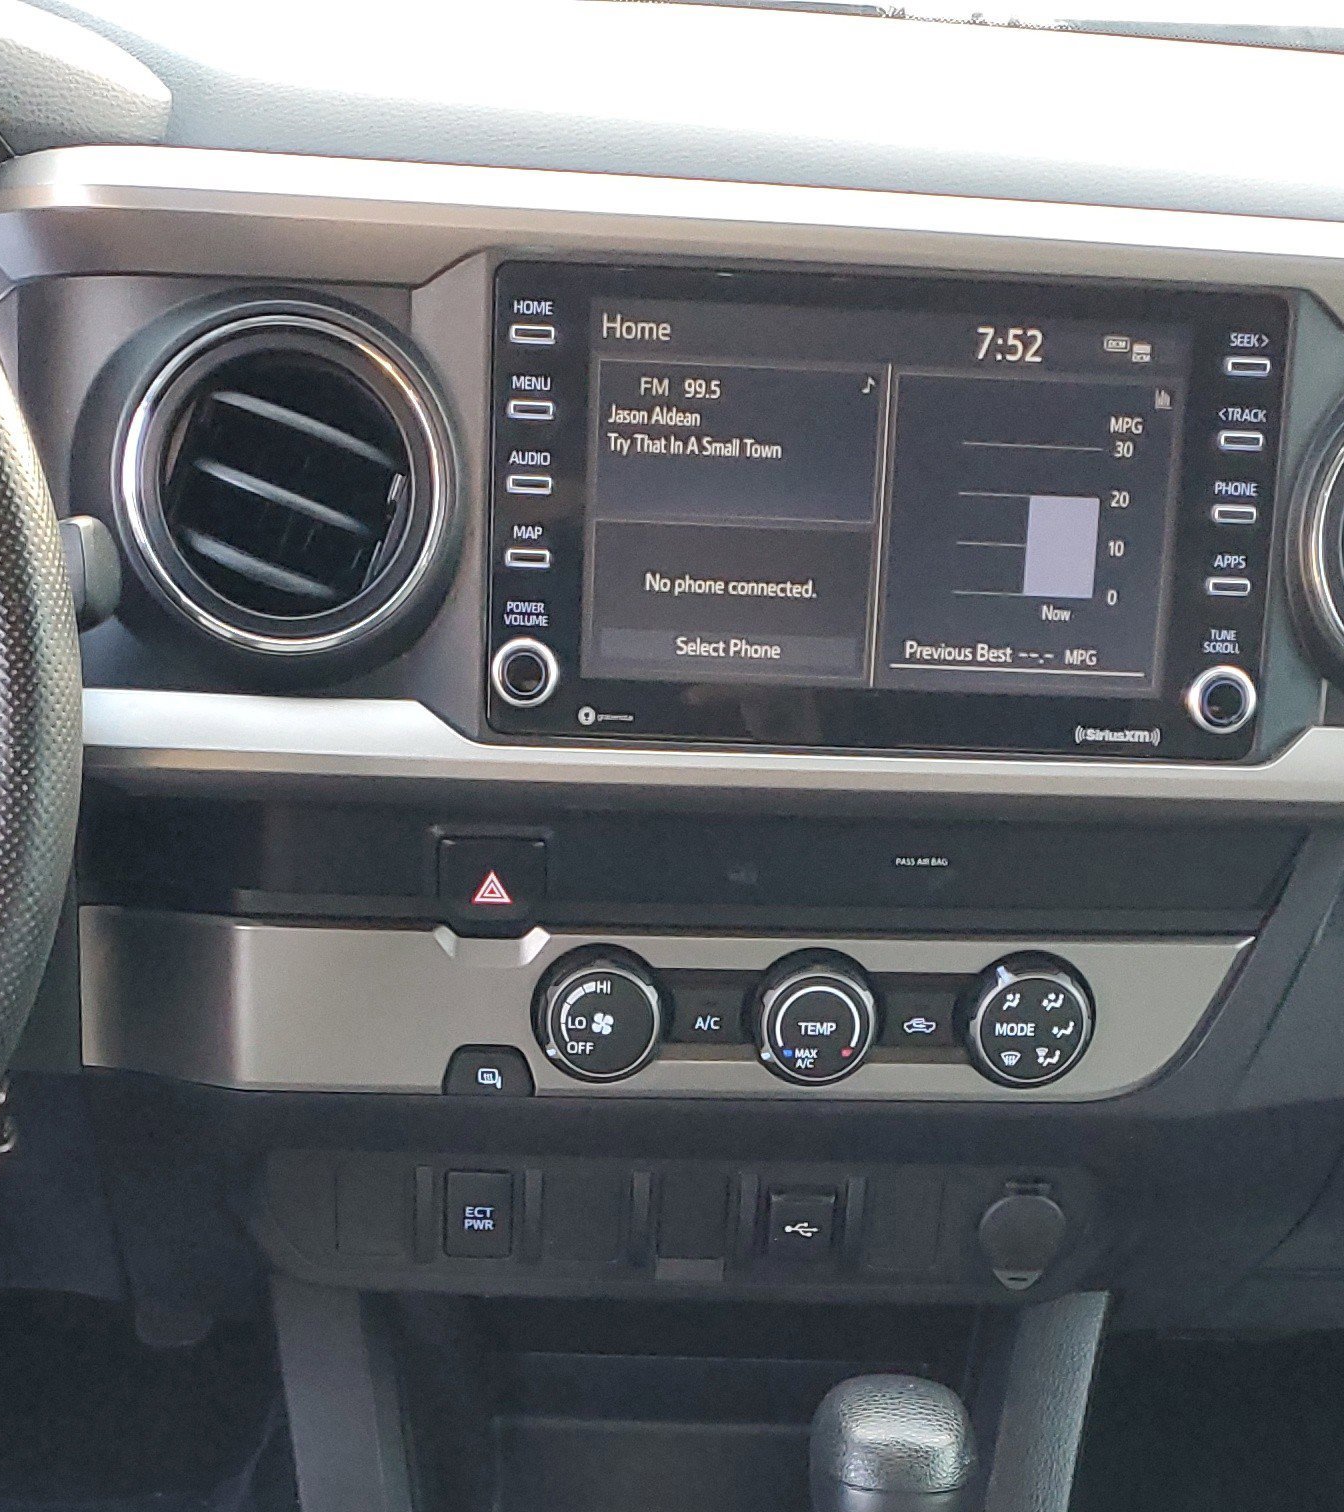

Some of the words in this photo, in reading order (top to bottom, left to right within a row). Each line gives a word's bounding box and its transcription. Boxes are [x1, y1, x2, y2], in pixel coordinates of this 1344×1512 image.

[513, 300, 553, 316] HOME
[602, 312, 671, 341] Home
[976, 326, 1043, 363] 7:52
[512, 375, 551, 391] MENU
[640, 377, 670, 397] FM
[684, 379, 721, 399] 99.5
[607, 404, 648, 425] Jason
[650, 405, 701, 427] Aldean
[1109, 416, 1143, 434] MPG
[607, 432, 631, 456] Try
[633, 433, 667, 454] That
[669, 435, 684, 455] In
[685, 436, 699, 455] A
[702, 436, 740, 457] Small
[742, 438, 782, 459] Town
[1114, 441, 1134, 458] 30
[508, 450, 551, 466] AUDIO
[1214, 481, 1258, 497] PHONE
[1110, 490, 1130, 508] 20
[513, 525, 543, 540] MAP
[1108, 540, 1125, 557] 10
[1213, 554, 1246, 569] APPS
[645, 572, 669, 592] No
[673, 574, 726, 598] phone
[727, 579, 817, 598] connected.
[1107, 590, 1118, 606] 0
[506, 601, 545, 614] POWER
[1041, 604, 1071, 621] Now
[503, 613, 549, 627] VOLUME
[1210, 628, 1237, 641] TUNE
[675, 636, 726, 657] Select
[729, 638, 781, 659] Phone
[904, 640, 973, 665] Previous
[976, 643, 1013, 663] Best
[1064, 649, 1098, 666] MPG
[1203, 640, 1241, 655] SCROLL
[596, 980, 611, 994] HI
[567, 1015, 587, 1030] LO
[694, 1015, 720, 1031] A/C
[797, 1021, 837, 1036] TEMP
[994, 1022, 1036, 1037] MODE
[566, 1041, 594, 1055] OFF
[794, 1048, 818, 1061] MAX
[795, 1057, 815, 1069] A/C
[465, 1206, 494, 1218] ECT
[464, 1218, 494, 1230] PWR
